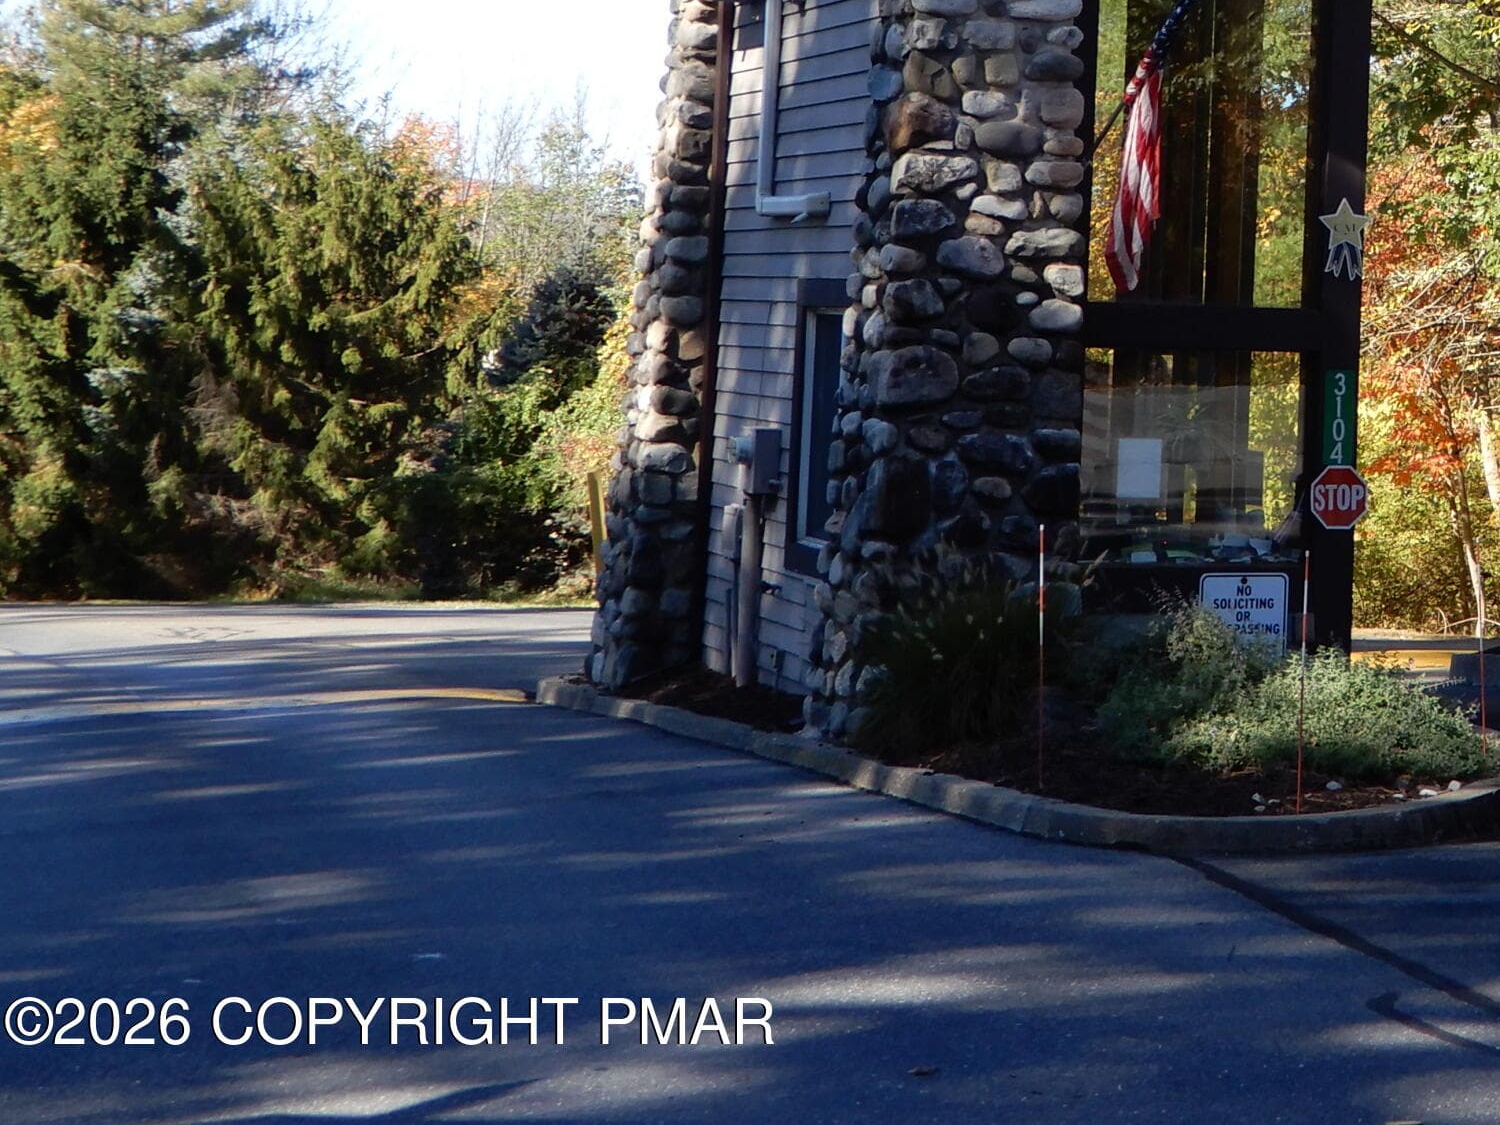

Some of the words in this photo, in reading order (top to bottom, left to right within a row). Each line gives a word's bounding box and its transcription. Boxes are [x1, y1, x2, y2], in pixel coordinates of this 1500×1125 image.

[1330, 373, 1346, 464] 3104
[1314, 484, 1364, 511] STOP
[1236, 585, 1252, 596] NO
[1213, 598, 1274, 609] SOLICITING
[1236, 611, 1251, 622] OR
